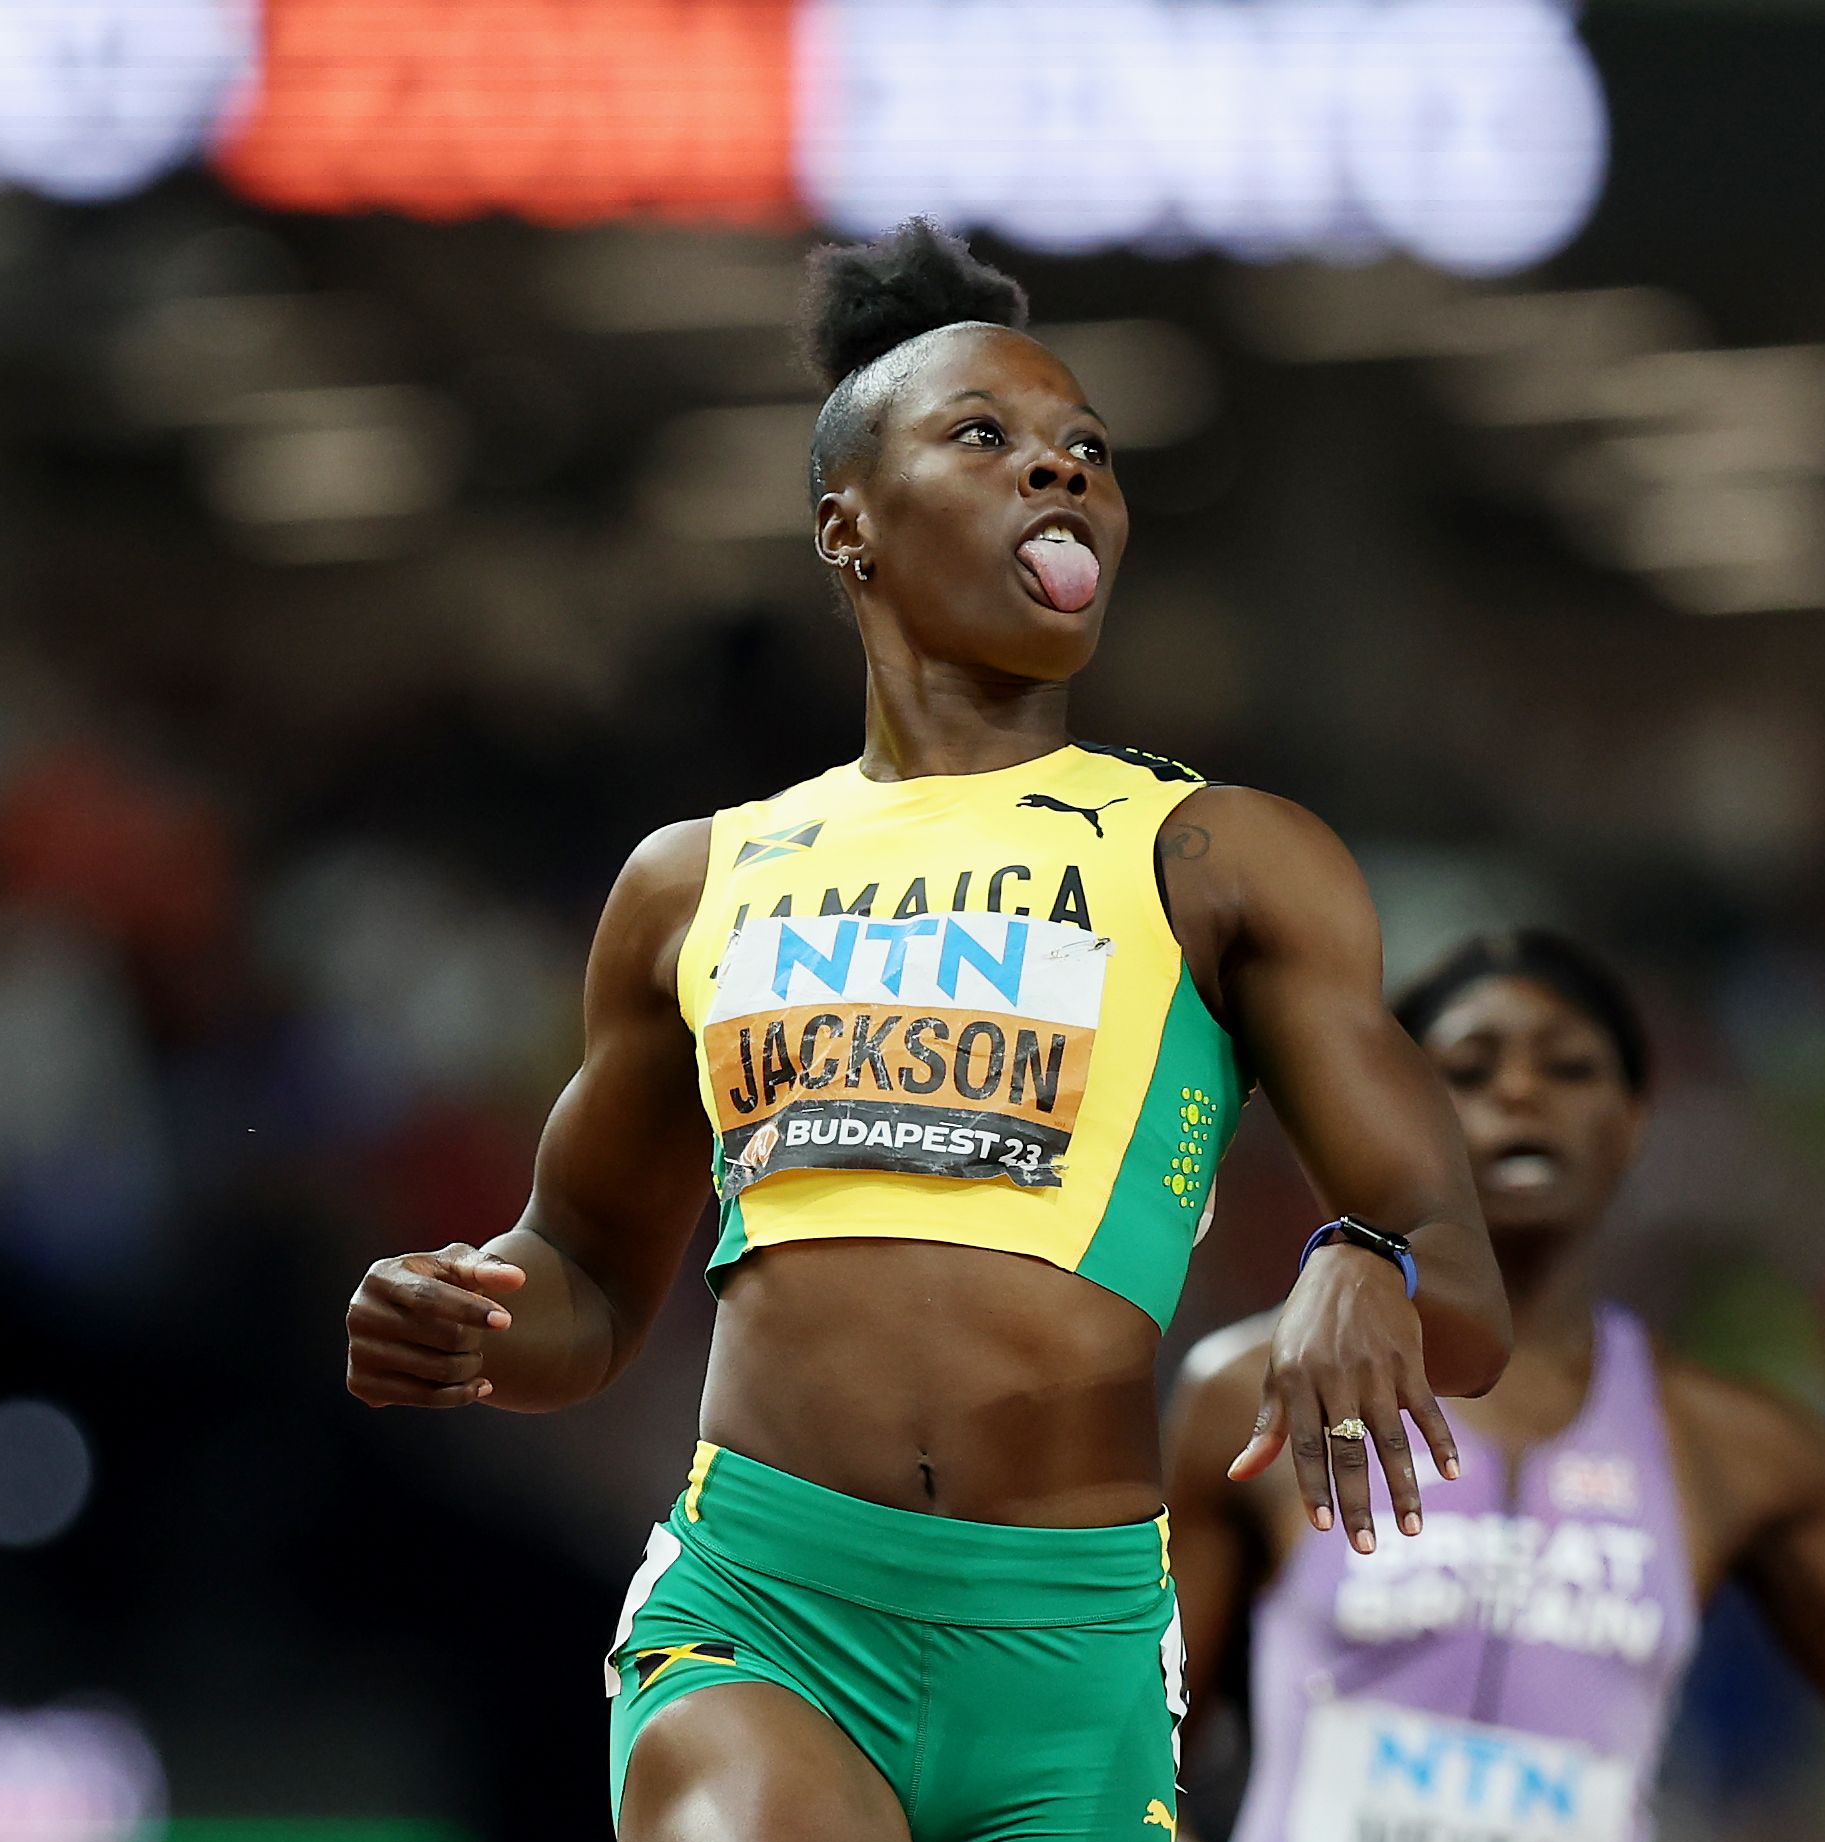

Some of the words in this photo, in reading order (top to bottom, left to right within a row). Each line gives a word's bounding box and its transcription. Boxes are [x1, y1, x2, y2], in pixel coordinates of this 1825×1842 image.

[771, 916, 1030, 1008] NTN
[729, 1013, 1067, 1115] JACKSON
[785, 1118, 1001, 1160] BUDAPEST
[998, 1137, 1044, 1172] 23
[1371, 1720, 1579, 1819] NTN
